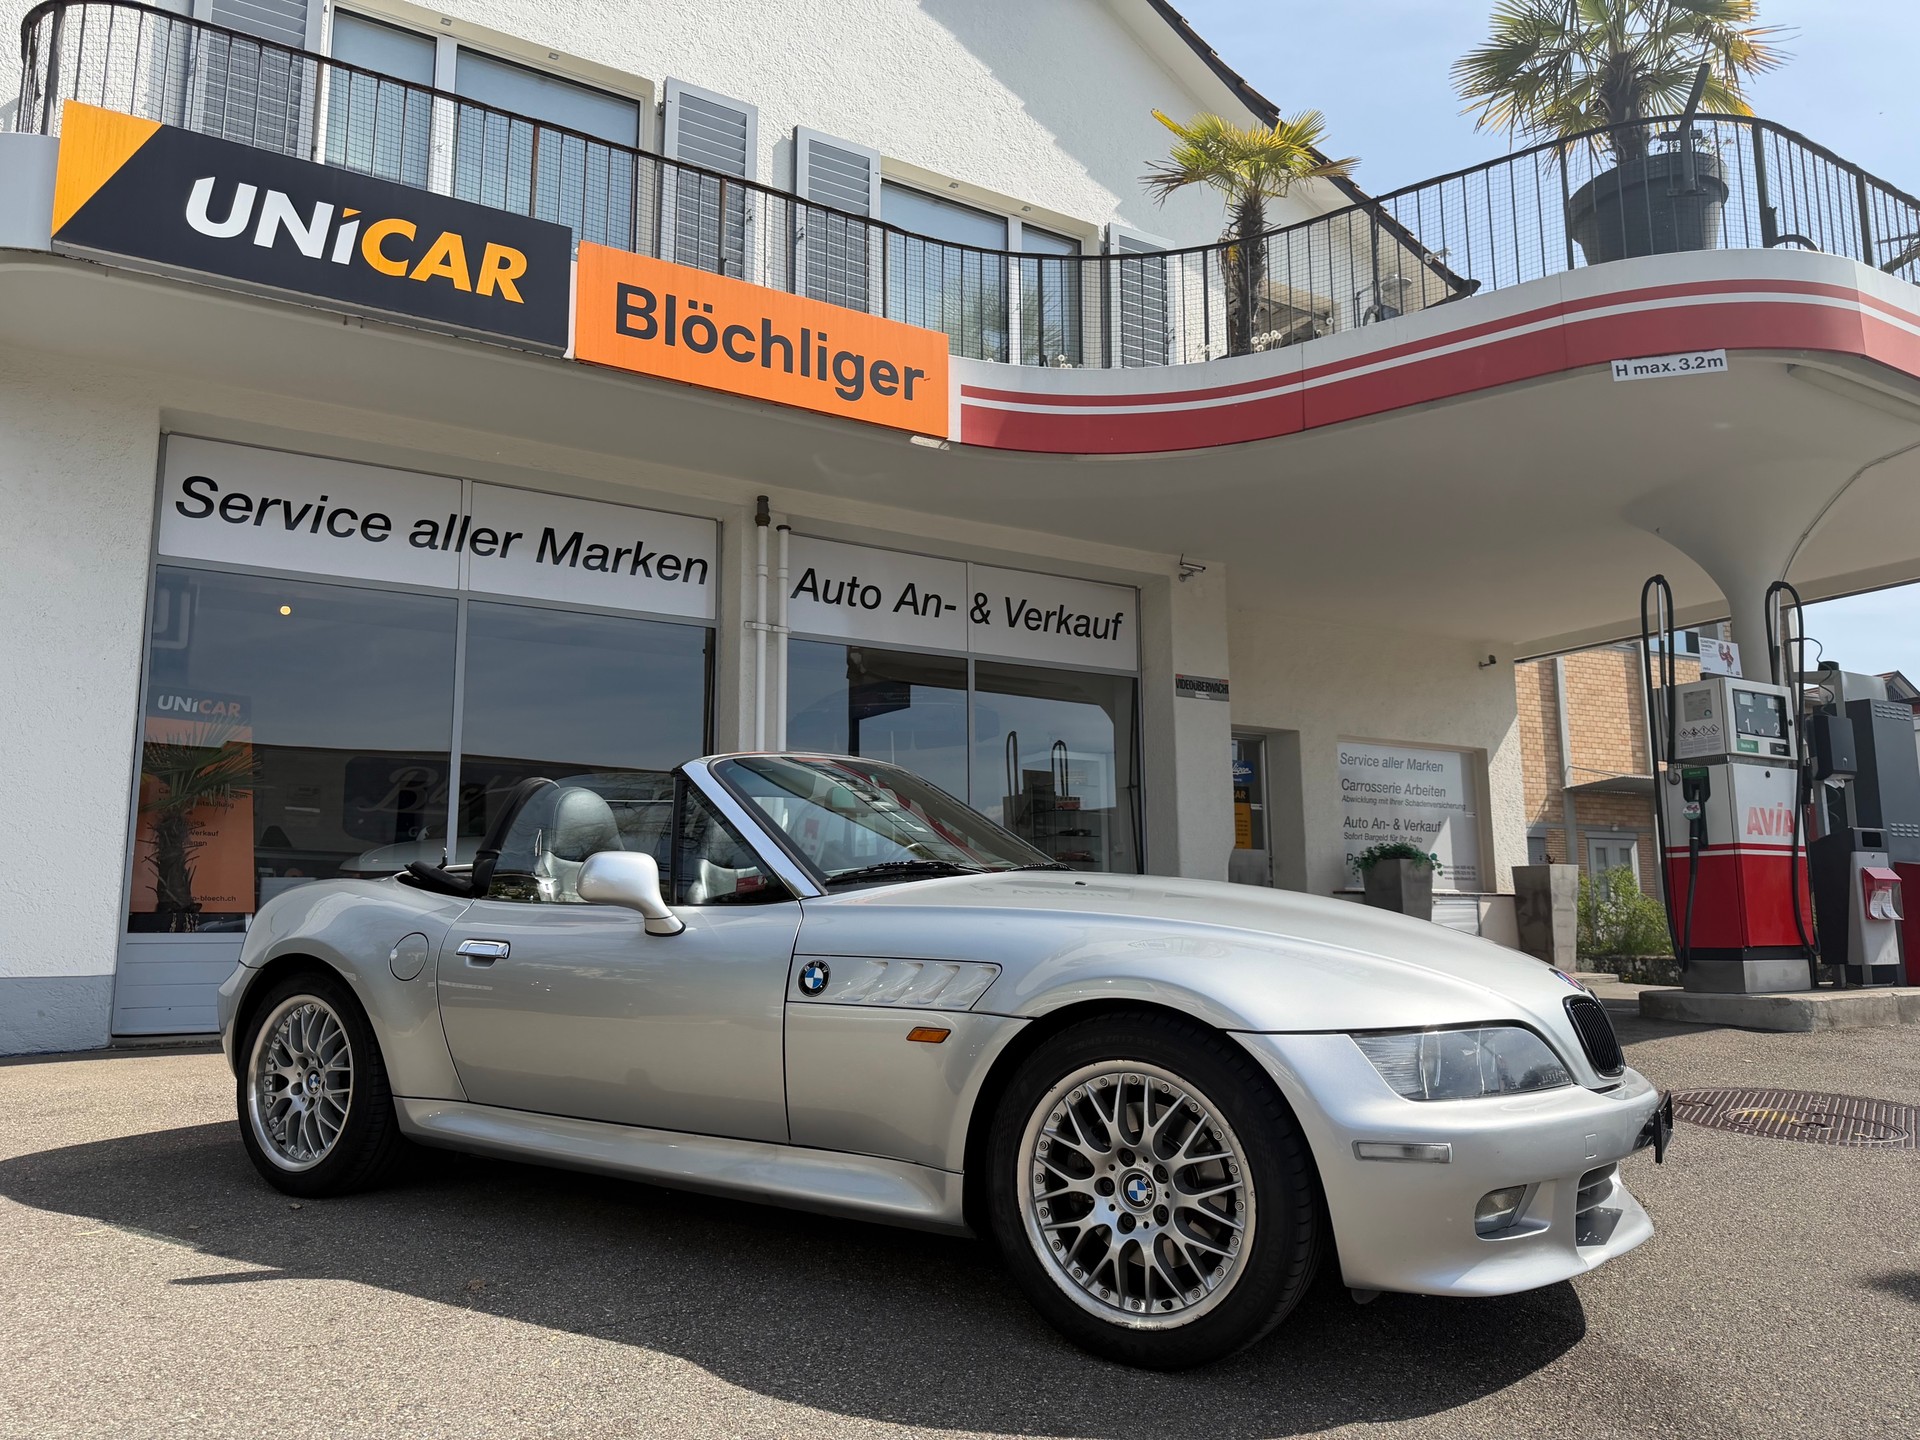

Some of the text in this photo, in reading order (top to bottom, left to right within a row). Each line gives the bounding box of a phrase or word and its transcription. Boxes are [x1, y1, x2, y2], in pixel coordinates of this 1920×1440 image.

[616, 281, 925, 401] Blöchliger
[1615, 356, 1723, 377] H max. 3.2m
[175, 475, 708, 585] Service aller Marken
[790, 567, 1124, 640] Auto An- & Verkauf
[1745, 718, 1751, 732] 1
[1340, 752, 1444, 773] Service aller Marken
[1341, 778, 1446, 797] Carrosserie Arbeiten
[1342, 795, 1378, 806] Abwicklung
[1379, 797, 1389, 805] mit
[1405, 799, 1466, 811] Schadenversicherung
[1343, 816, 1442, 832] Auto An- & Verkauf
[1344, 832, 1363, 840] Sofort
[1364, 833, 1388, 843] Bargeld
[1409, 835, 1423, 843] Auto
